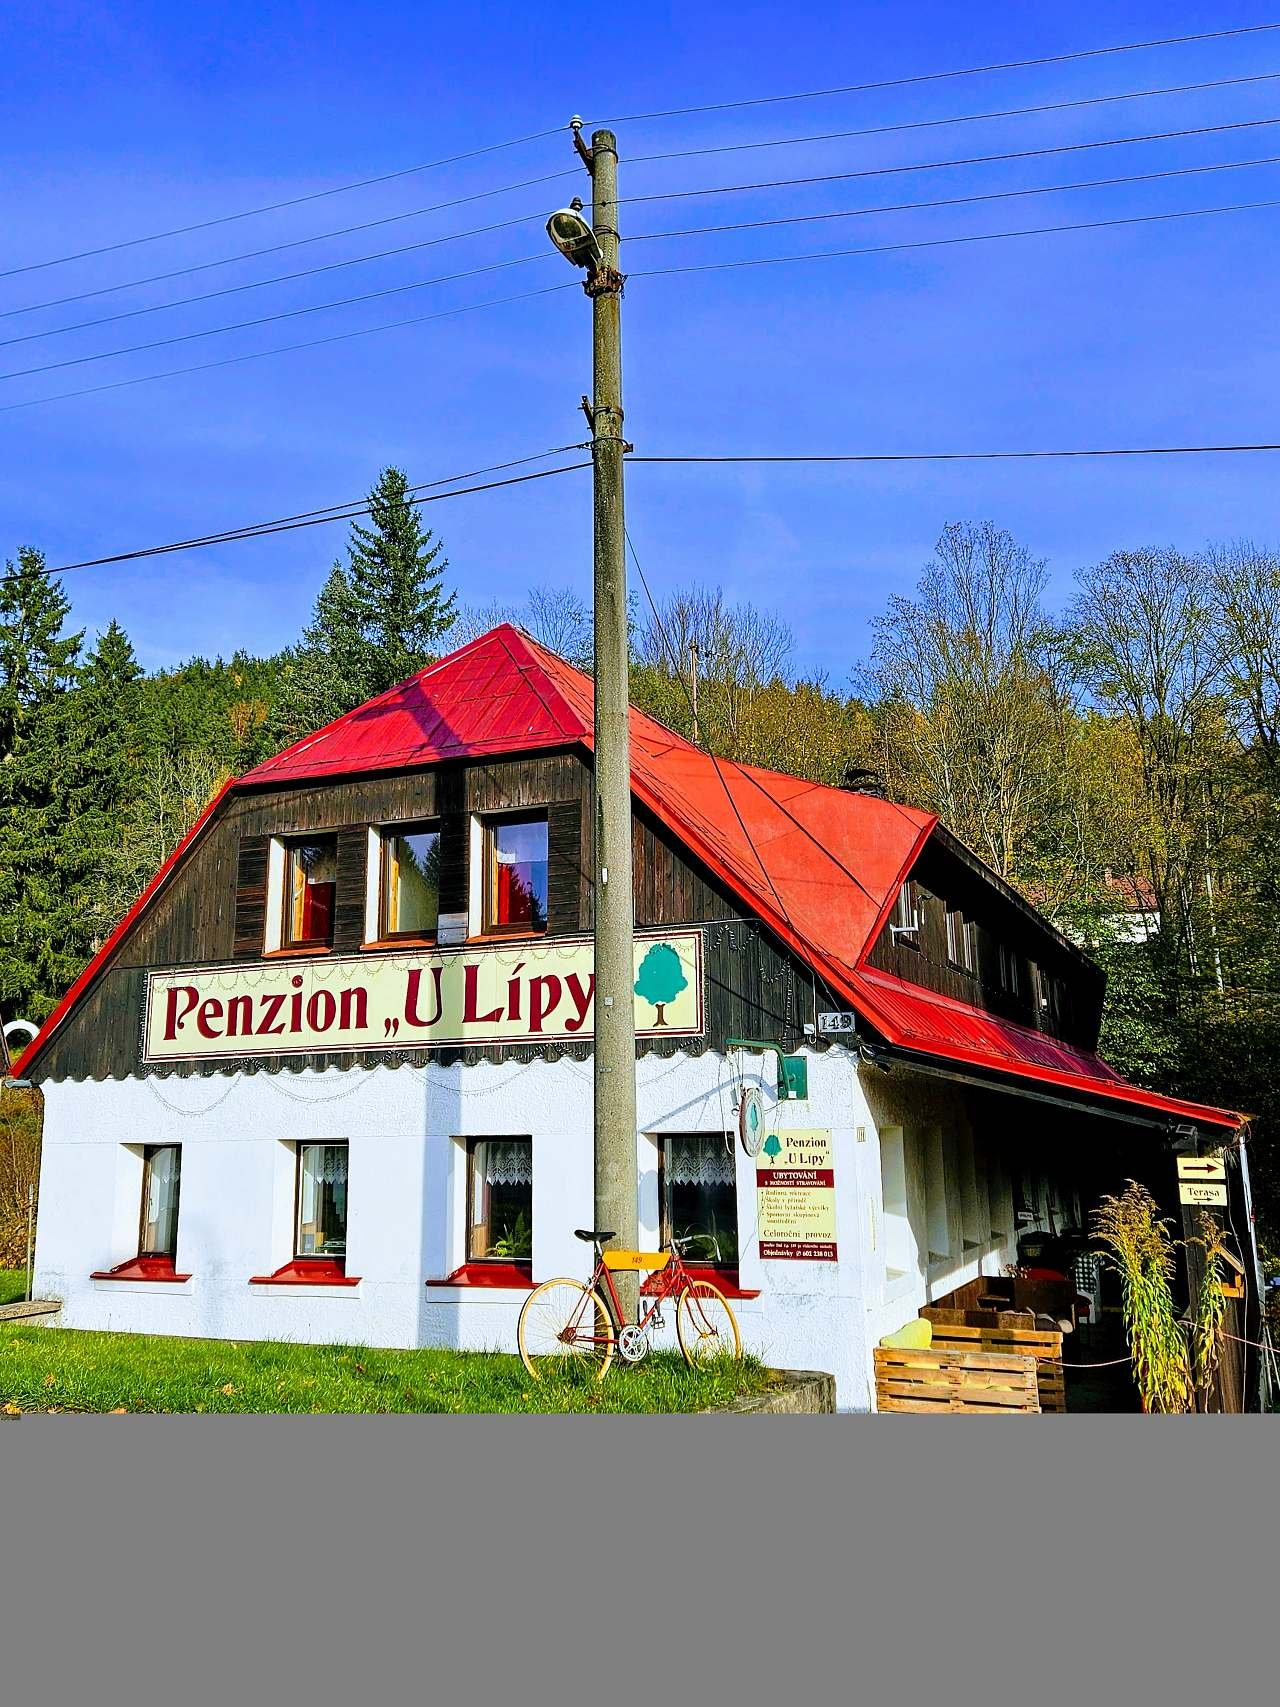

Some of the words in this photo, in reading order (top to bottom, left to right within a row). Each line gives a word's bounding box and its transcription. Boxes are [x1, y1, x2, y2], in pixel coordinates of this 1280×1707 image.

[163, 975, 368, 1041] Penzion
[822, 1015, 851, 1030] 149
[786, 1137, 826, 1147] Penzion
[773, 1171, 817, 1180] UBYTOVÁNÍ
[1187, 1187, 1220, 1196] Terasa
[763, 1229, 801, 1238] Celoroční
[763, 1249, 793, 1257] Objednávky
